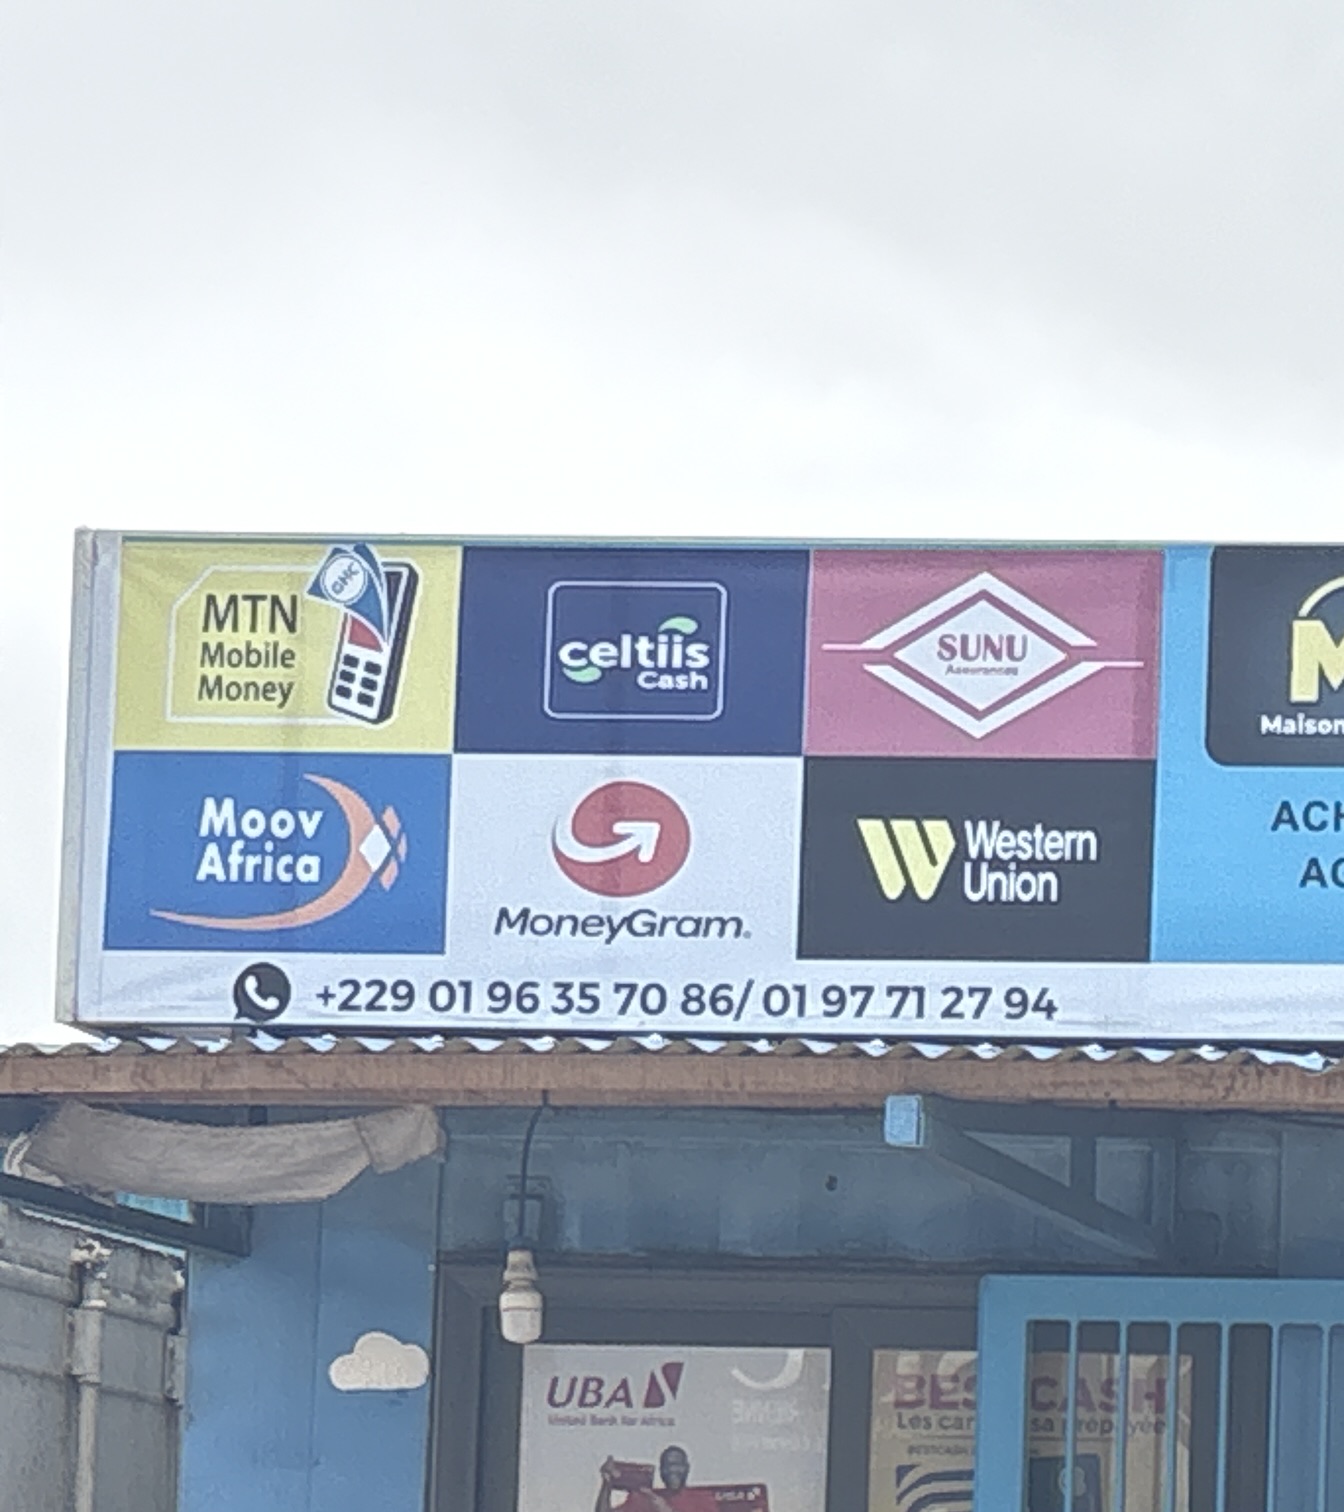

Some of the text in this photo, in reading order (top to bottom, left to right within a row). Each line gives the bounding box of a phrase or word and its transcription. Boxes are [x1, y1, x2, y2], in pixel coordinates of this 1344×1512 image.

[202, 594, 298, 634] MTN
[200, 641, 296, 669] Mobile
[558, 631, 710, 671] celtiis
[937, 633, 1028, 662] SUNU
[198, 674, 294, 708] Money
[637, 670, 708, 691] Cash
[199, 796, 324, 838] Moov
[963, 819, 1098, 861] Western
[196, 841, 321, 884] Africa
[963, 862, 1059, 902] Union
[315, 979, 416, 1015] +229
[429, 980, 472, 1015] 01
[487, 980, 540, 1015] 96
[551, 981, 600, 1015] 35
[613, 982, 667, 1016] 70
[821, 983, 874, 1019] 97
[885, 985, 926, 1019] 71
[940, 985, 992, 1020] 27
[1003, 985, 1058, 1020] 94
[546, 1375, 634, 1409] UBA
[897, 1414, 932, 1431] Les
